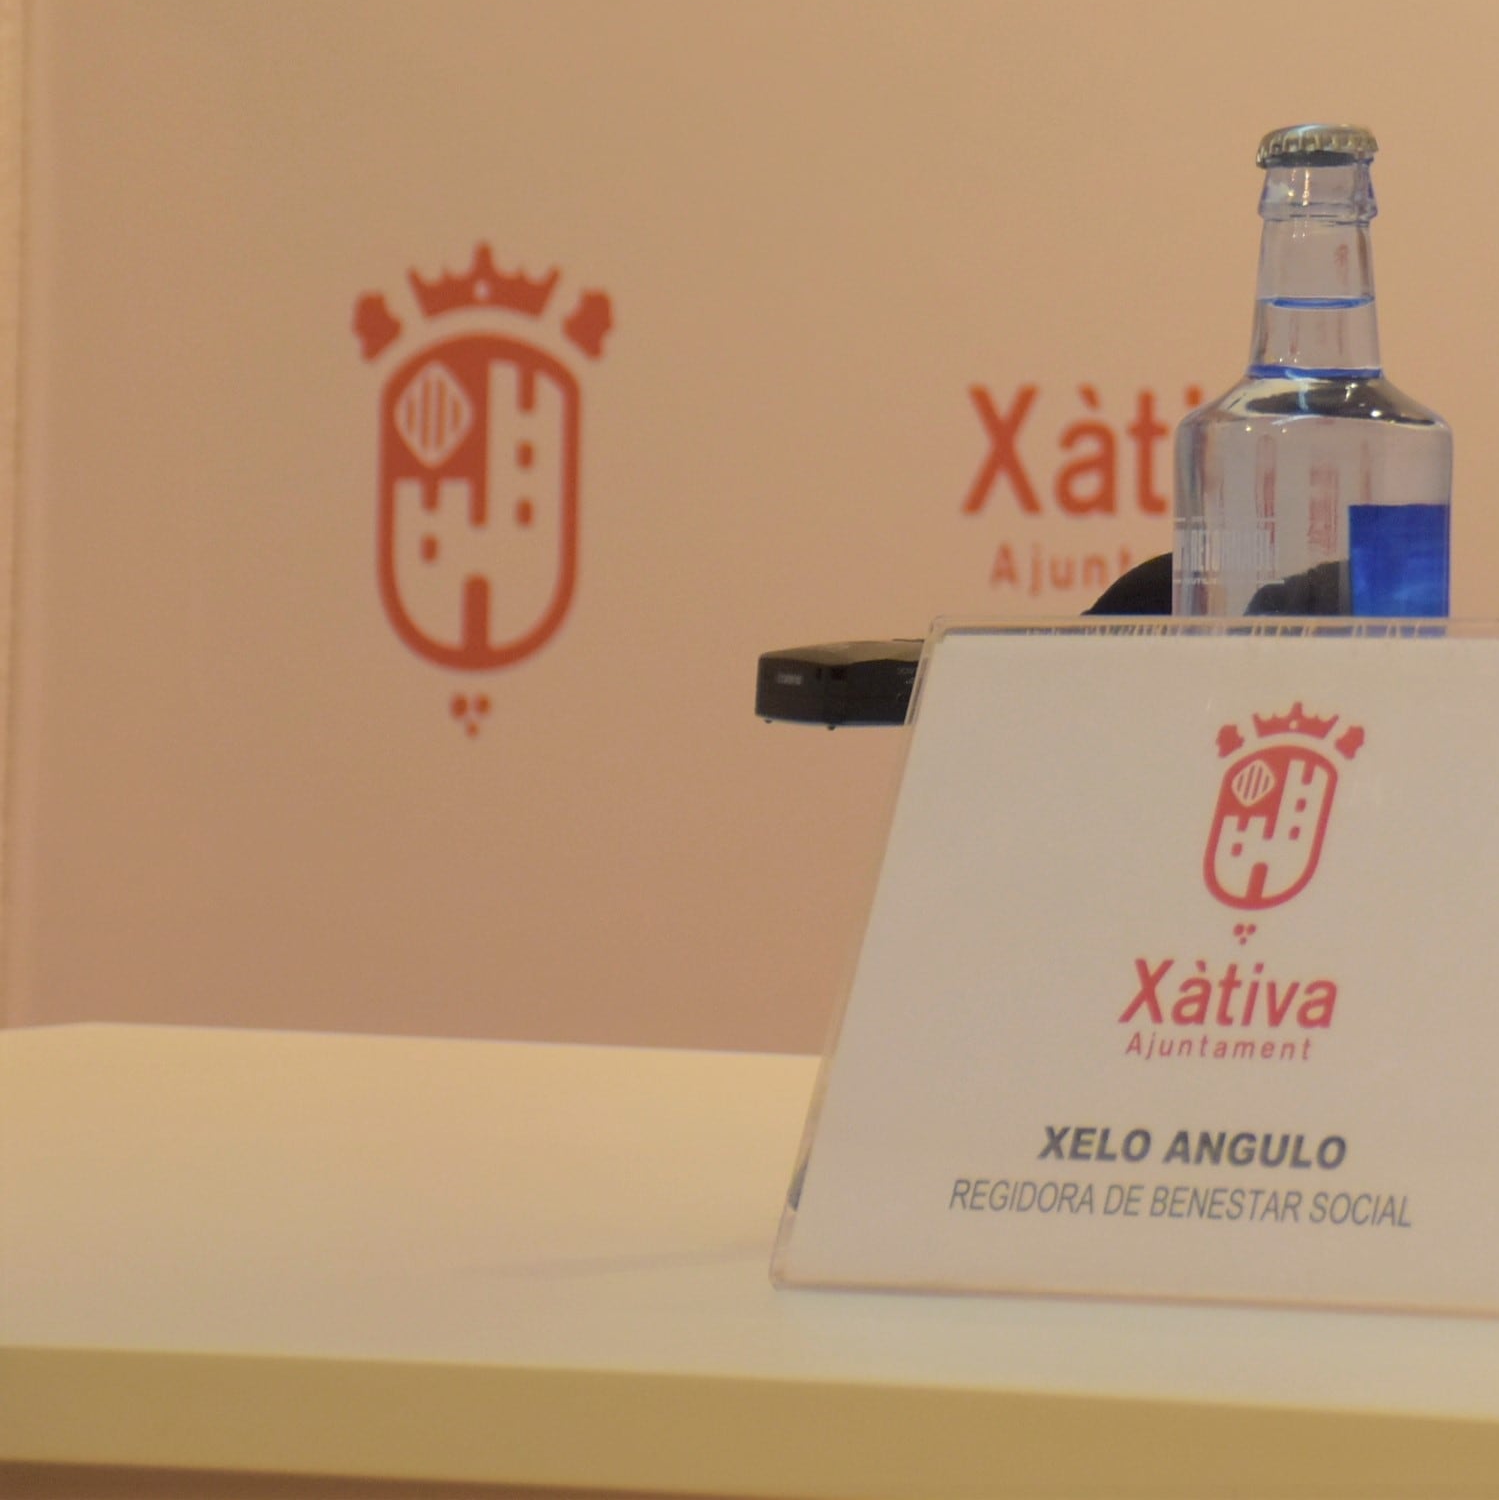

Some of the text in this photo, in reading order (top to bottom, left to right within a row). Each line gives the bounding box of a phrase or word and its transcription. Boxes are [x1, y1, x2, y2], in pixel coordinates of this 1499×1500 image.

[1118, 957, 1339, 1030] Xàtiva
[1126, 1031, 1312, 1060] Ajuntament
[1037, 1125, 1348, 1171] XELO ANGULO
[949, 1178, 1411, 1229] REGIDORA DE BENESTAR SOCIAL
